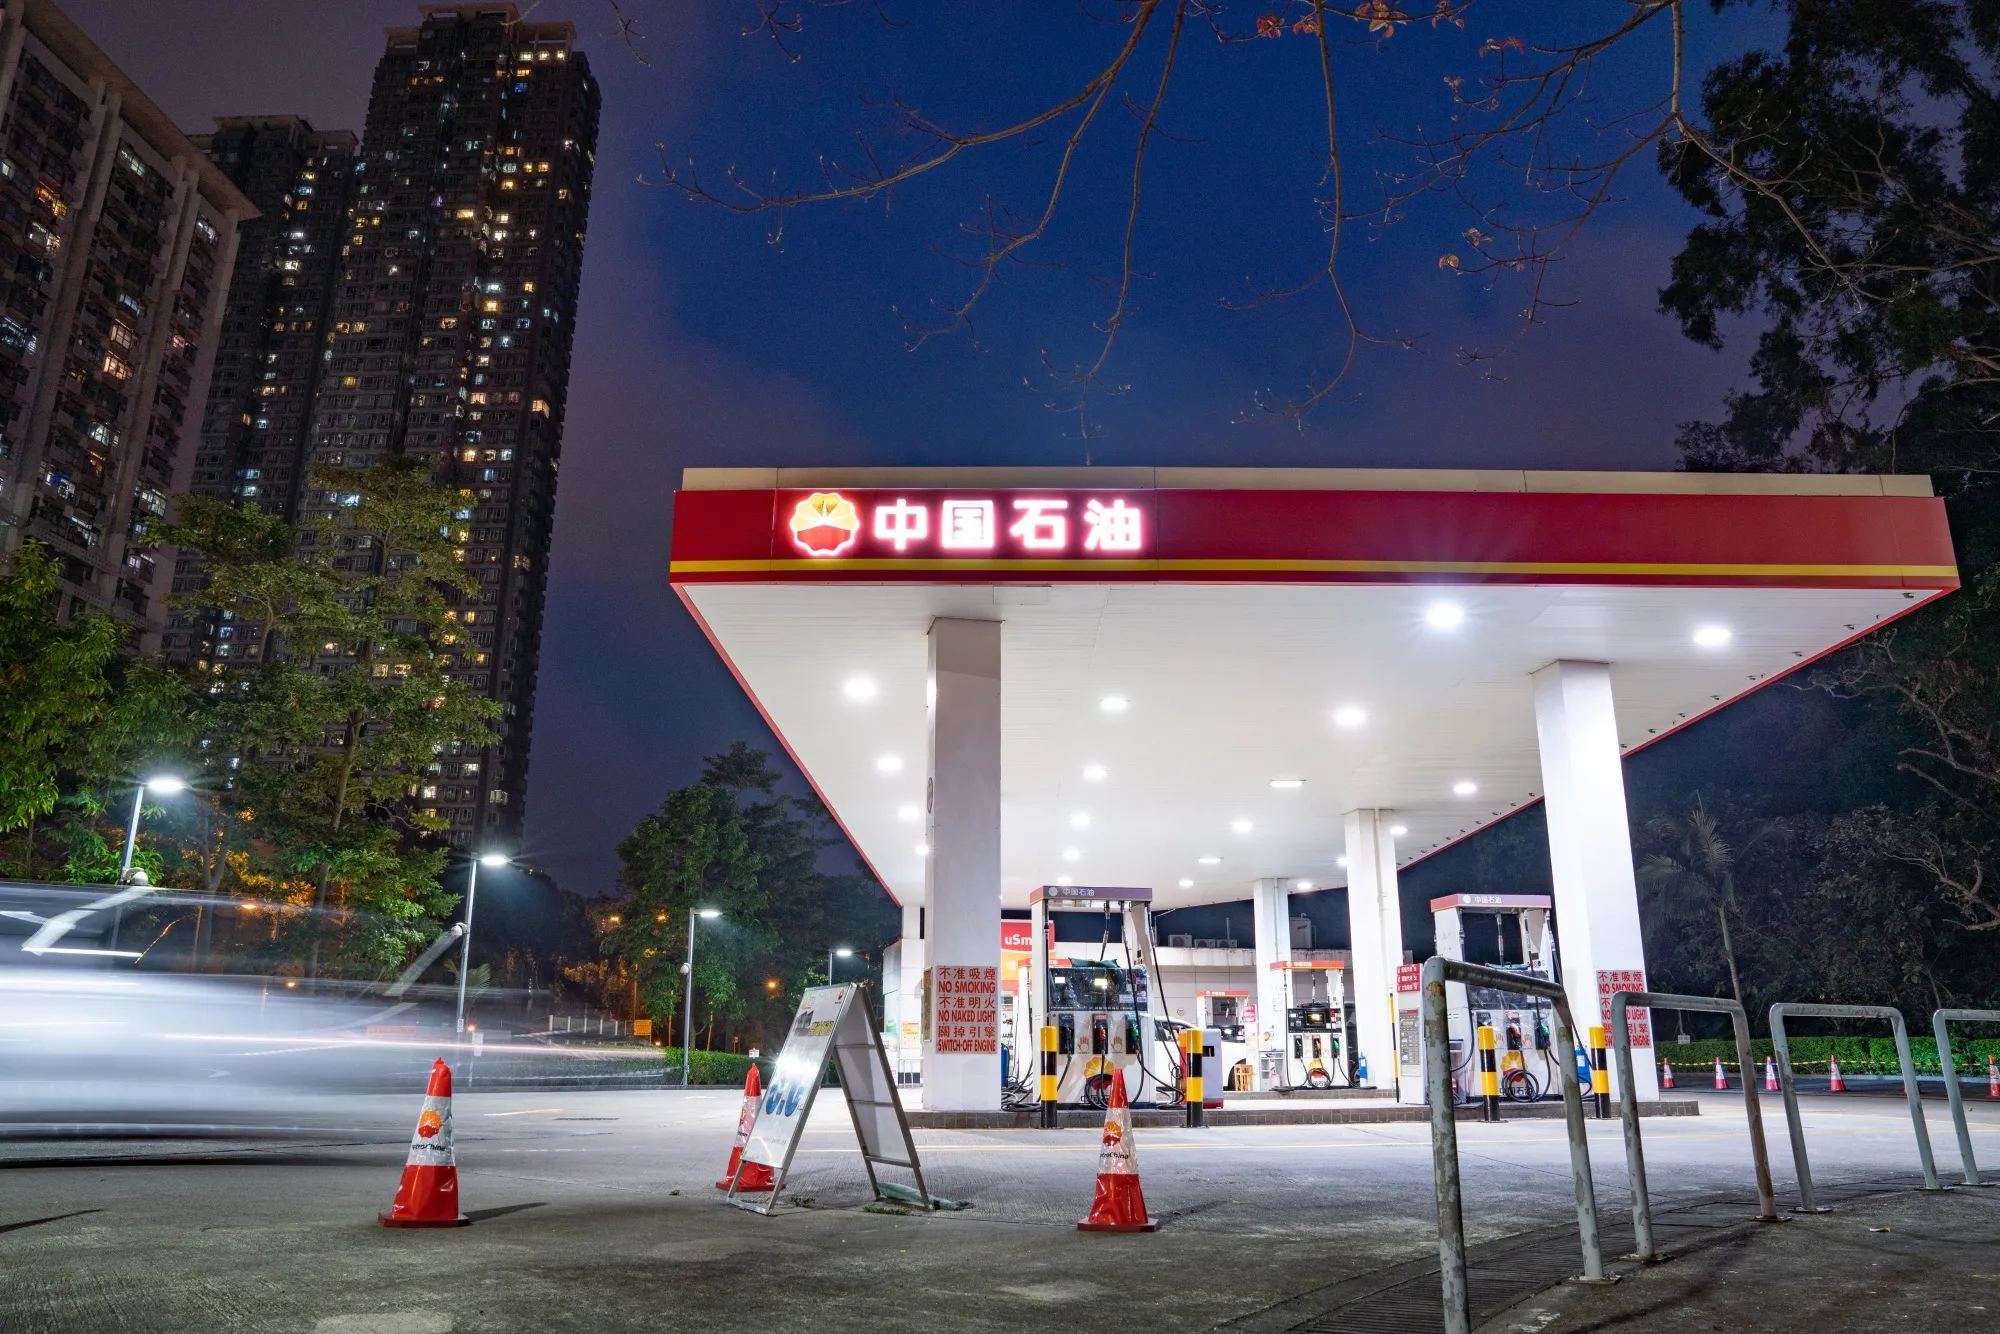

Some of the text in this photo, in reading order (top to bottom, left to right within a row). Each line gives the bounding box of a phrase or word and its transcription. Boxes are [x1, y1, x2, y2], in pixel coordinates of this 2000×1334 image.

[874, 498, 1141, 551] 中国石油
[1062, 887, 1095, 897] 中国石油
[1474, 895, 1502, 904] 中国石油
[1004, 933, 1032, 946] uSm
[938, 967, 996, 981] 不准吸煙
[1598, 971, 1642, 982] 不准吸煙
[938, 981, 996, 993] NO SMOKING
[1600, 983, 1610, 994] NO
[938, 996, 995, 1009] 不准明火
[938, 1010, 996, 1023] NO NAKED LIGHT
[1632, 1010, 1647, 1020] LIGHT
[937, 1025, 996, 1038] 關掉引擎
[1603, 1022, 1648, 1034] 關引擎
[937, 1039, 996, 1052] SWITCH-OFF ENGINE
[1633, 1035, 1650, 1046] ENGINE
